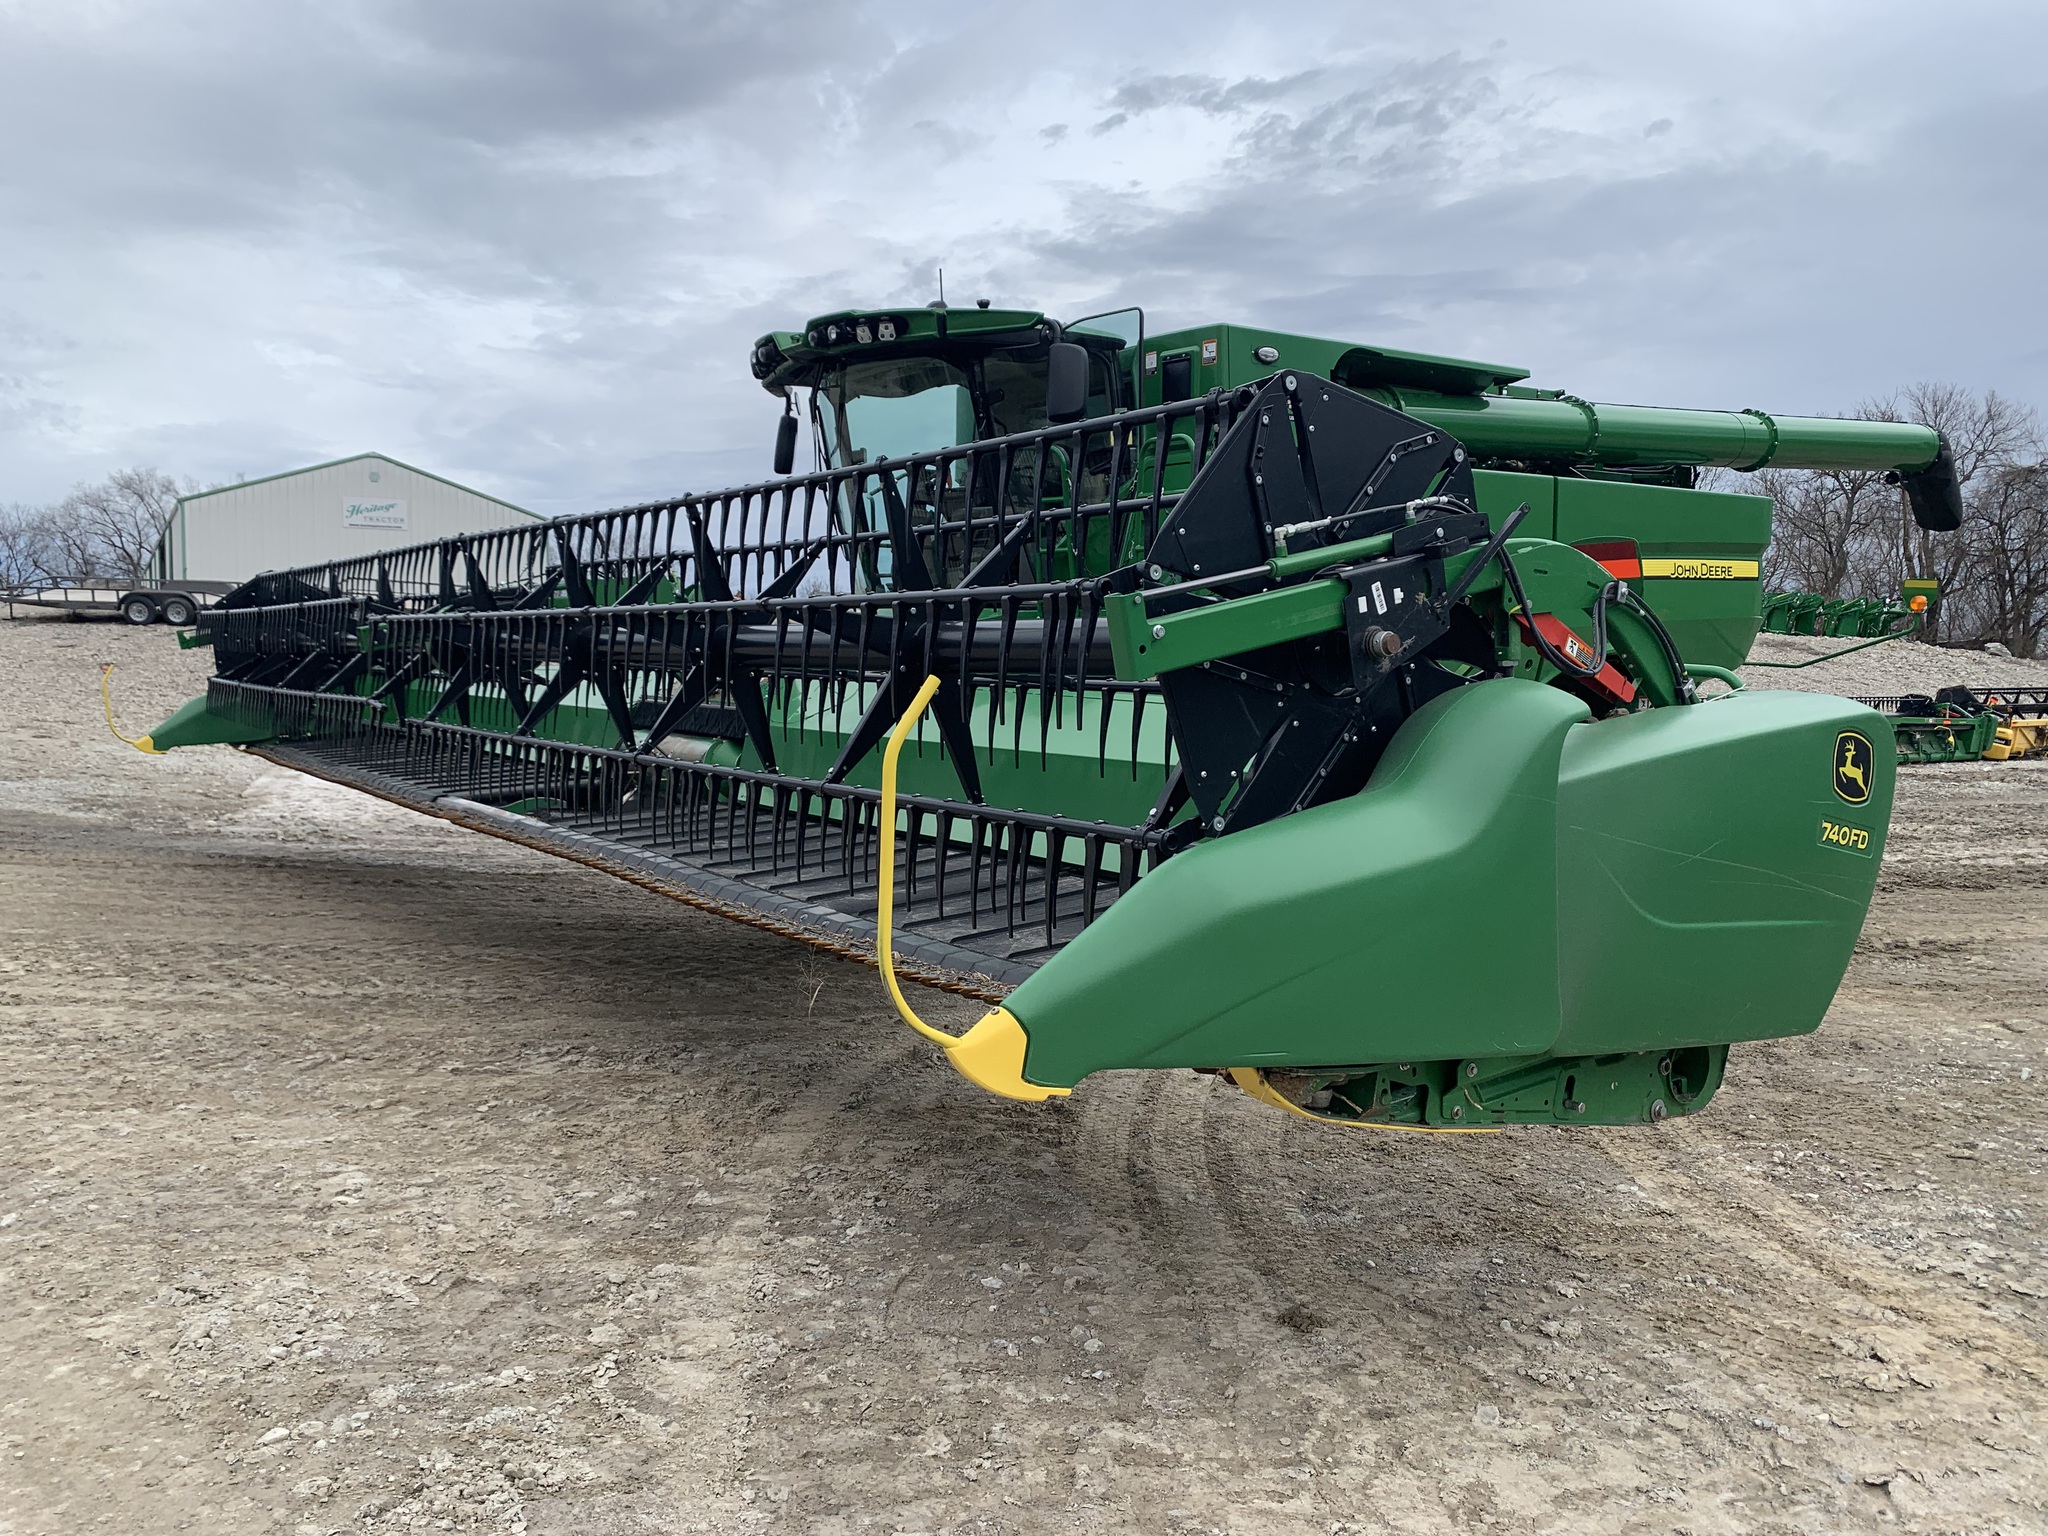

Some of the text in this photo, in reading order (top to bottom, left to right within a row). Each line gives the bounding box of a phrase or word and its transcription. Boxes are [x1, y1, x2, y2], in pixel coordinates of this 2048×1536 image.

[345, 502, 398, 519] Heritage
[363, 515, 406, 523] TRACTOR
[1670, 562, 1734, 577] JOHN DEERE
[1821, 820, 1869, 850] 740FD
